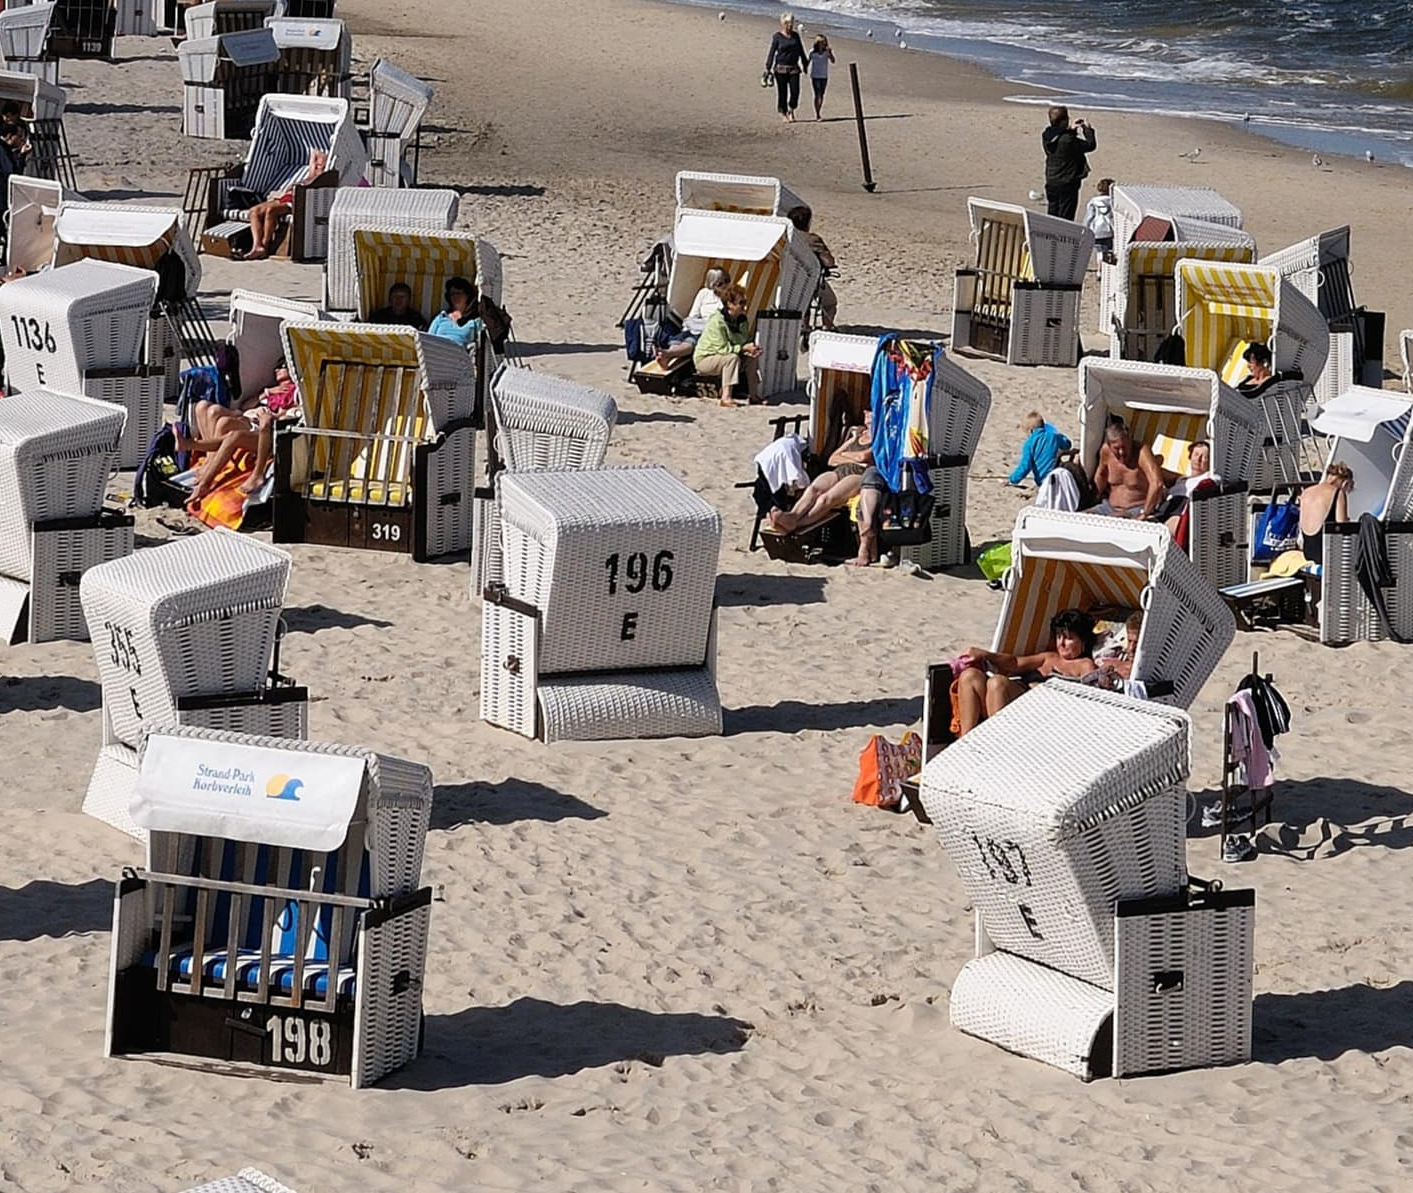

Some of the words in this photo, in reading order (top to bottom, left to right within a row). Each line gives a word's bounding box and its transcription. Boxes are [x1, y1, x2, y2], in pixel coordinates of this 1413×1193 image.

[11, 315, 57, 354] 1136
[36, 363, 46, 384] E
[372, 523, 400, 541] 319
[605, 550, 674, 595] 196
[620, 612, 638, 640] E
[129, 686, 143, 720] E
[192, 778, 252, 796] Korbverleih
[1018, 904, 1045, 941] E
[266, 1015, 331, 1065] 198
